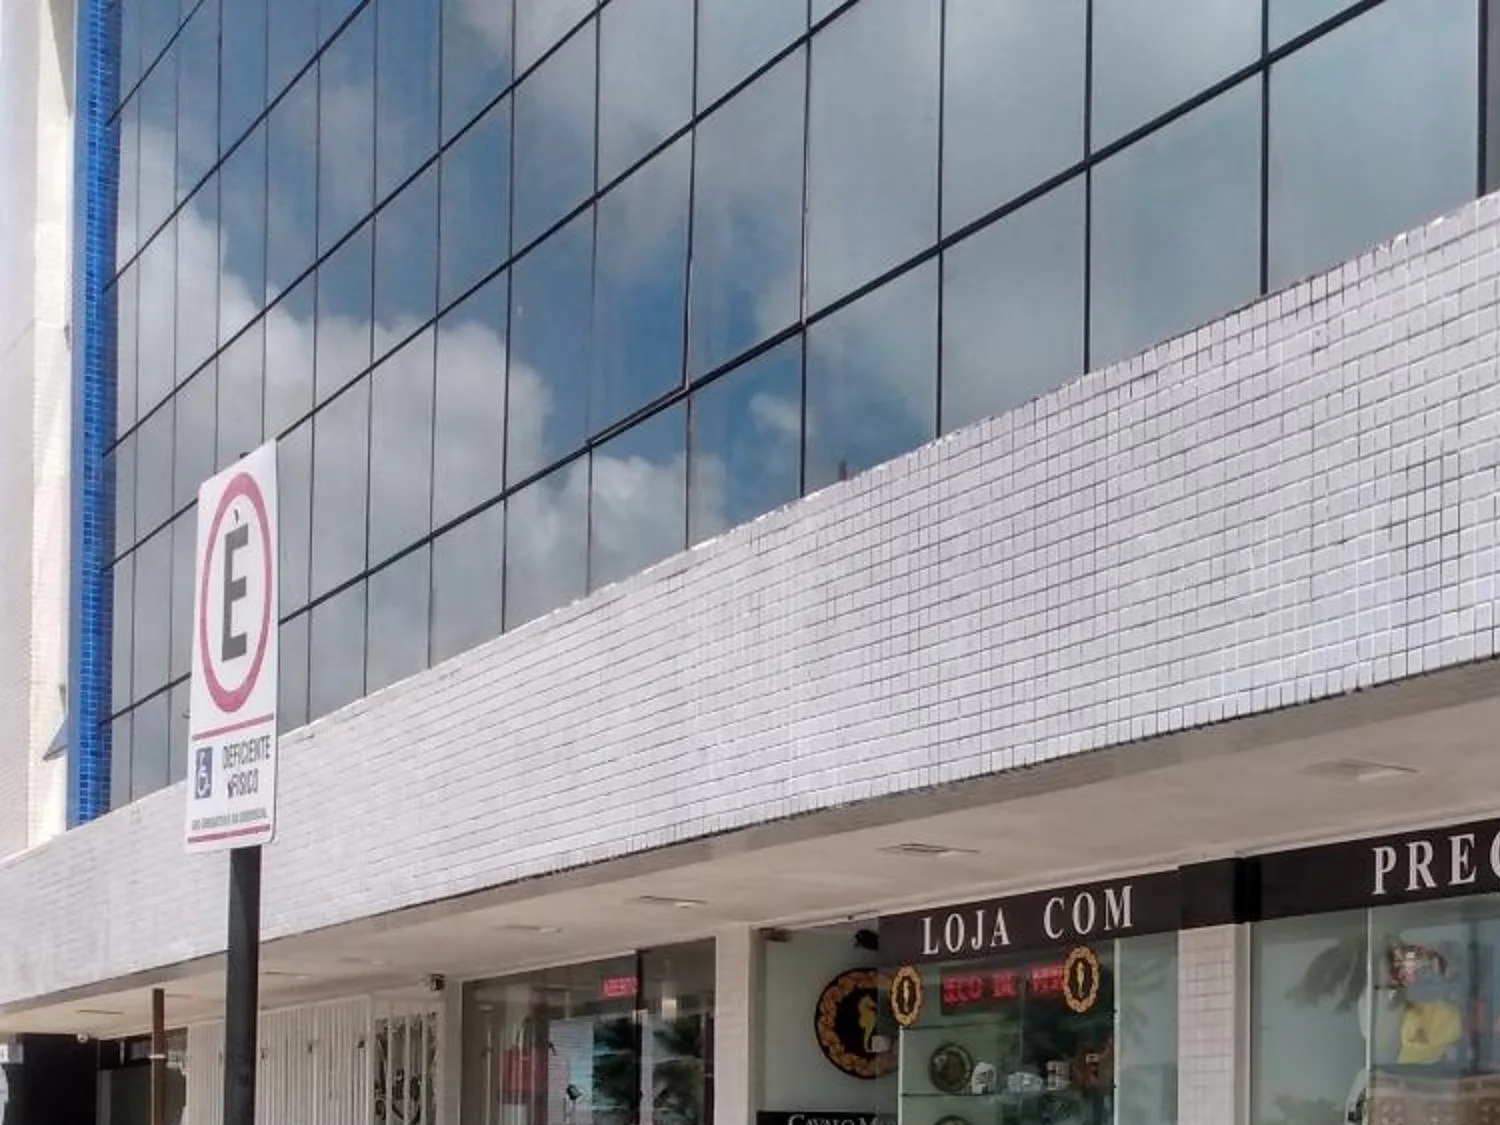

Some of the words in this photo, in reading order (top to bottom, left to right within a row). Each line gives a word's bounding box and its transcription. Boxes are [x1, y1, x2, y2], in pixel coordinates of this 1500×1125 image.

[221, 522, 250, 662] E
[921, 907, 1011, 955] LOJA
[1043, 885, 1133, 939] COM
